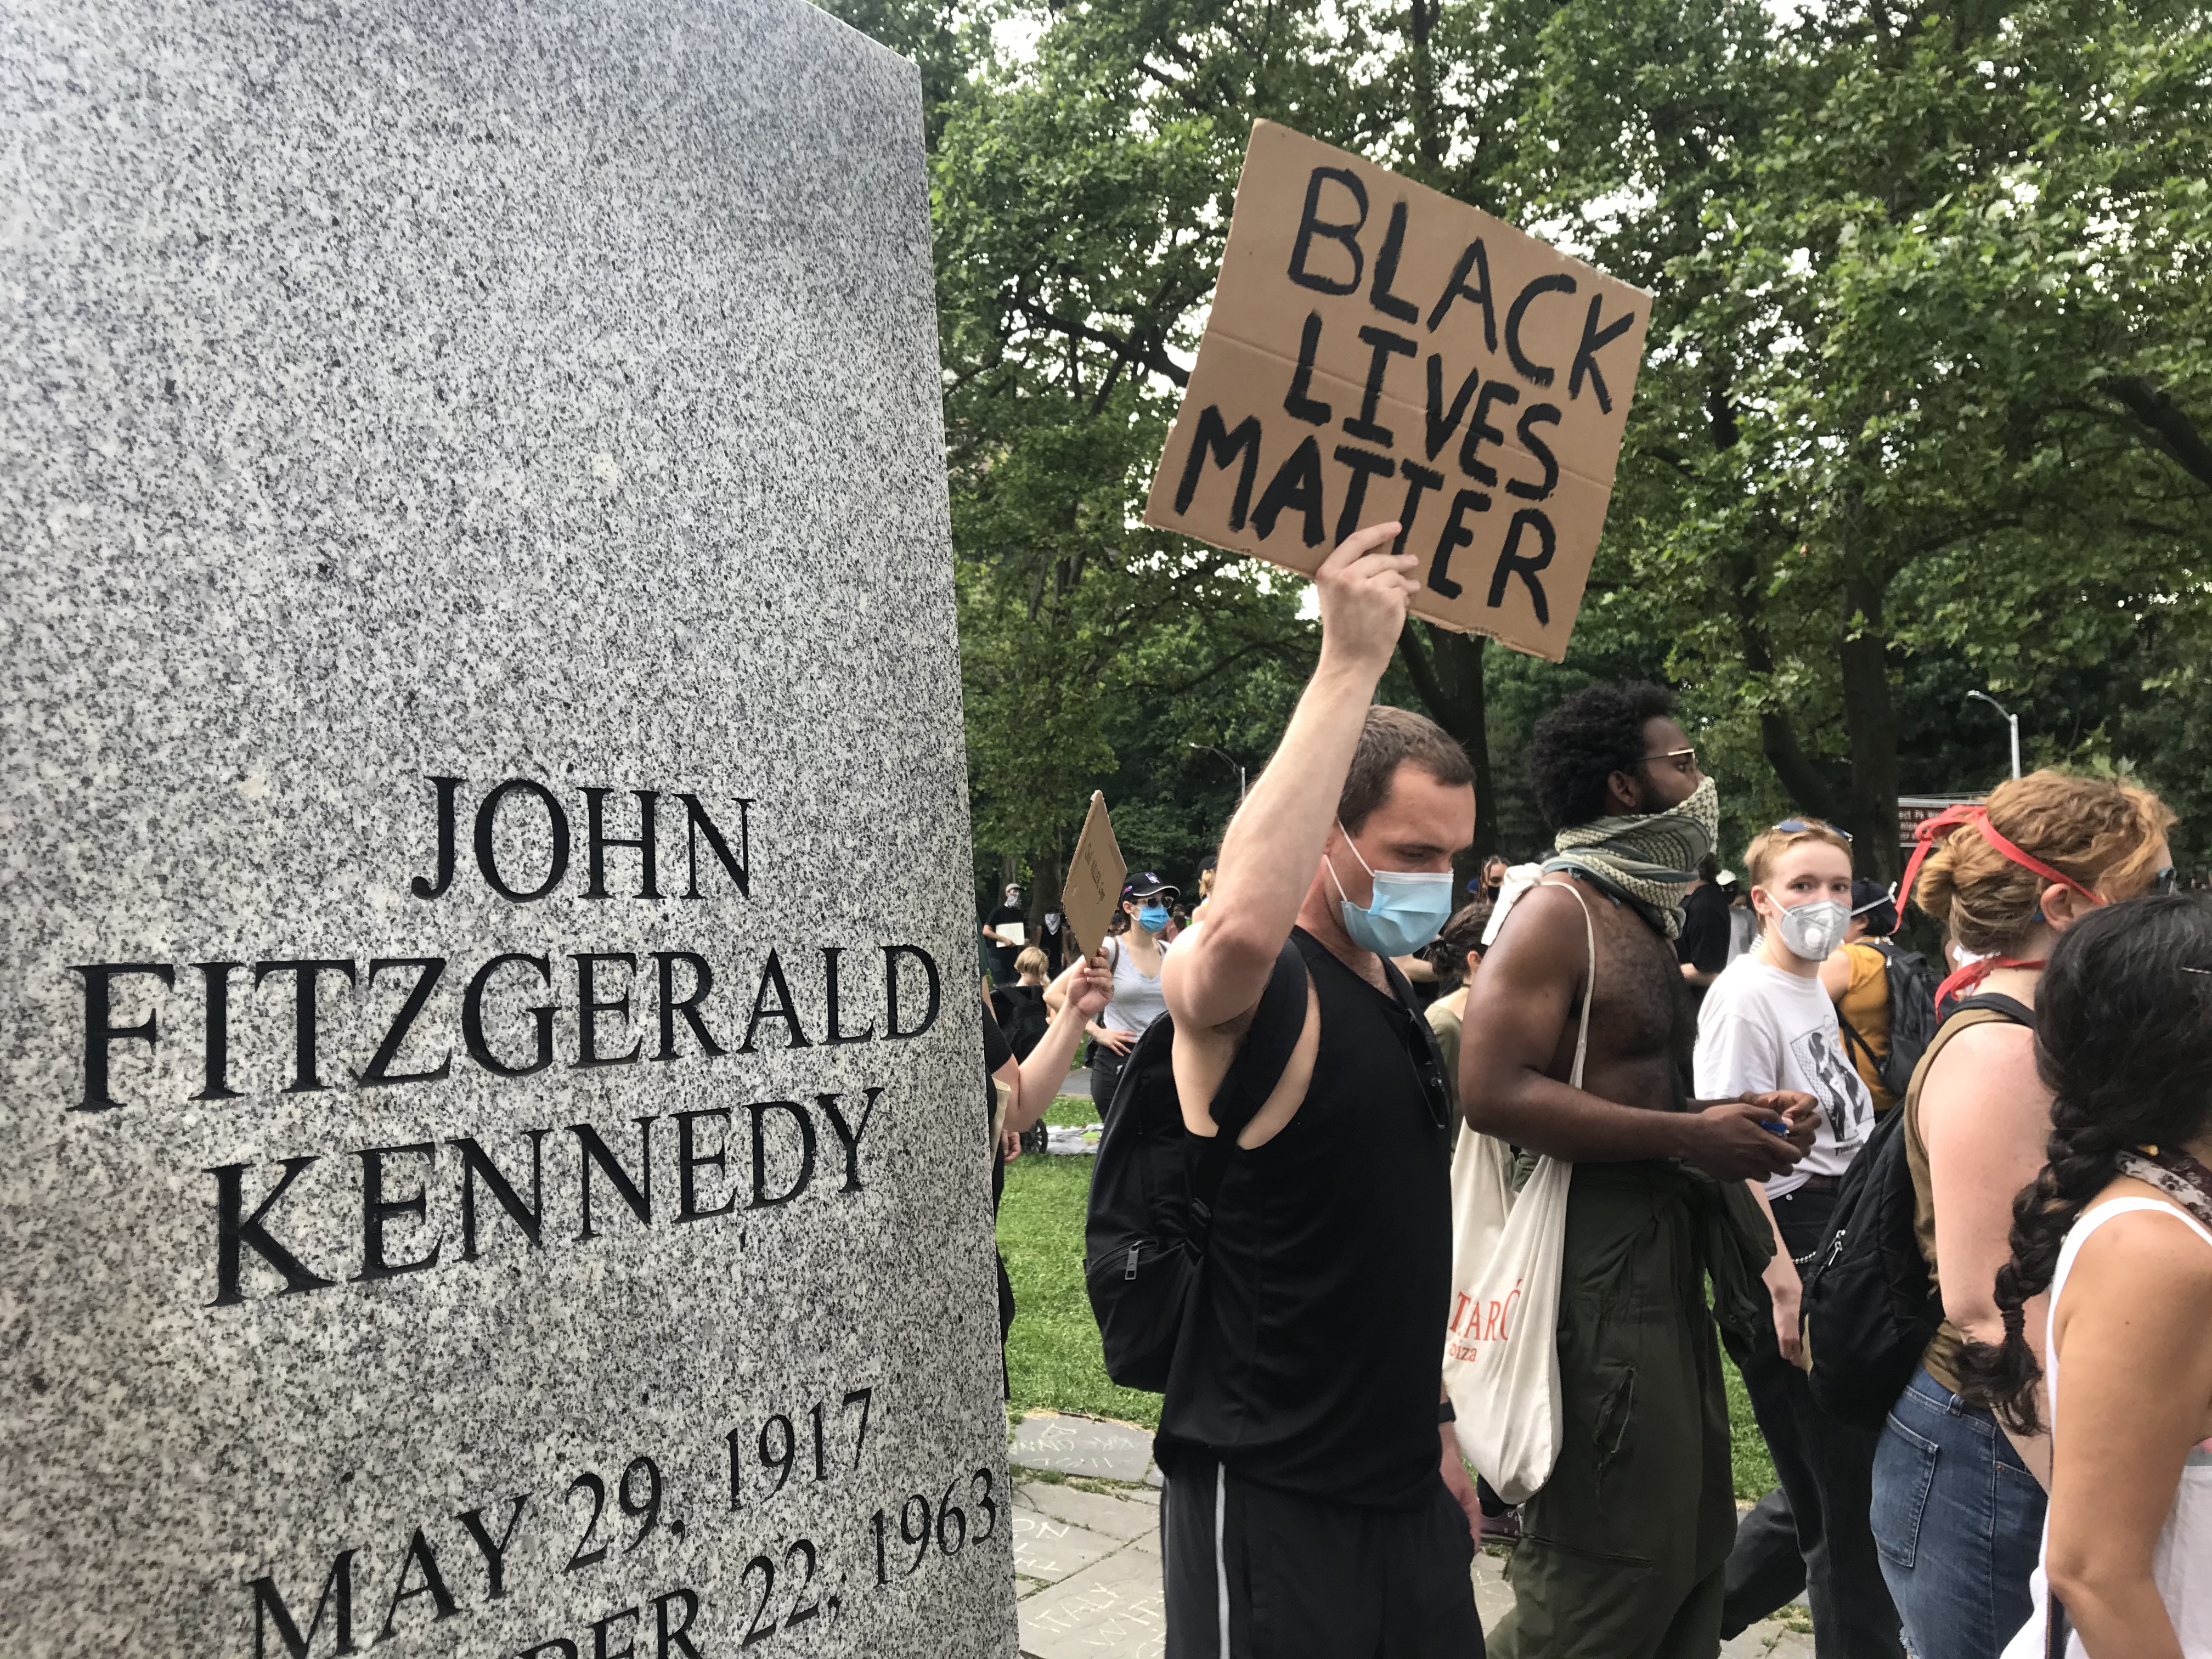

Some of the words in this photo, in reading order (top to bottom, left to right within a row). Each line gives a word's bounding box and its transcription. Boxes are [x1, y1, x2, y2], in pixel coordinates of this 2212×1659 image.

[1287, 166, 1635, 414] BLACK
[1284, 309, 1562, 501] LIVES
[1173, 404, 1556, 625] MATTER
[411, 776, 756, 903] JOHN
[65, 944, 941, 1112] FITZGERALD
[201, 1087, 885, 1308] KENNEDY
[244, 1492, 532, 1659] MAY
[565, 1455, 686, 1575] 29,
[725, 1387, 872, 1513] 1917
[517, 1587, 703, 1659] ER
[741, 1538, 841, 1647] 22,
[870, 1467, 998, 1589] 1963
